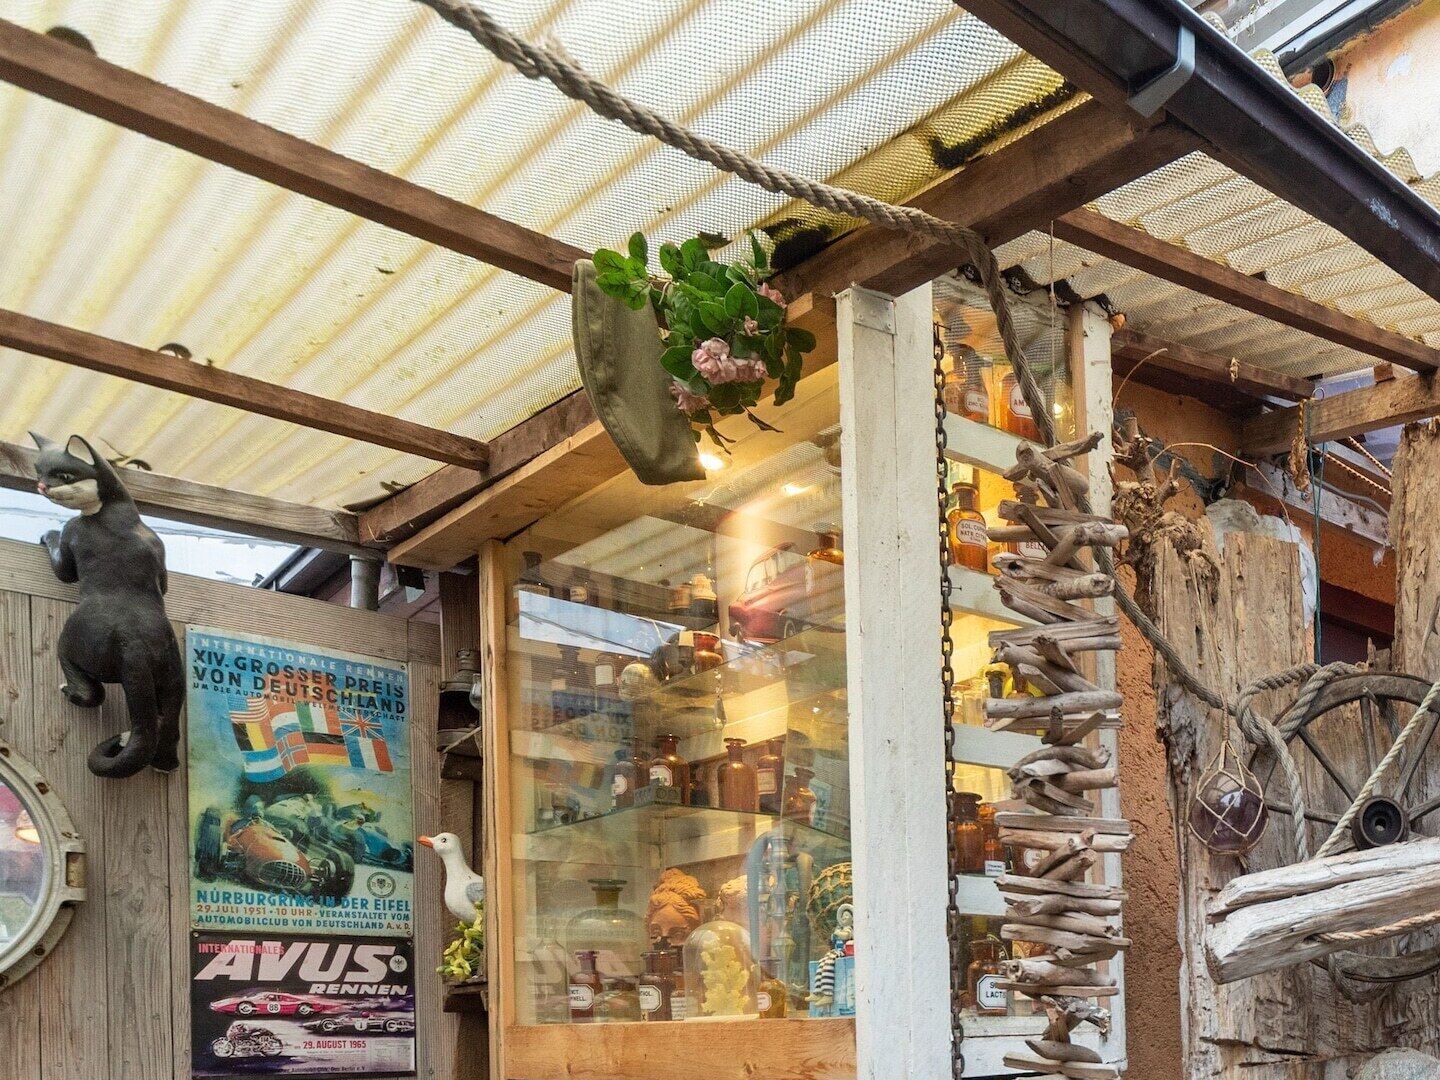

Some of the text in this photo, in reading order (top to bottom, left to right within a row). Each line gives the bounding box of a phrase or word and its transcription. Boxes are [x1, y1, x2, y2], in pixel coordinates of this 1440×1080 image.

[191, 637, 403, 681] INTERNATIONALE RENNEN
[193, 648, 404, 699] XIV. GROSSER PREIS
[193, 665, 405, 714] VON DEUTSCHLAND
[319, 895, 336, 908] IN
[341, 896, 369, 911] DER
[374, 898, 410, 912] EIFEL
[215, 906, 239, 914] JULI
[244, 907, 266, 915] 1951
[291, 909, 312, 917] UHR
[320, 910, 387, 920] VERANSTALTET
[391, 913, 410, 921] VOM
[197, 915, 289, 926] AUTOMOBILCLUB
[292, 919, 312, 927] VON
[316, 921, 384, 929] DEUTSCHLAND
[198, 943, 285, 955] INTERNATIONALES
[194, 940, 395, 983] AVUS
[309, 983, 407, 996] RENNEN
[303, 1040, 367, 1050] 29. AUGUST 1965
